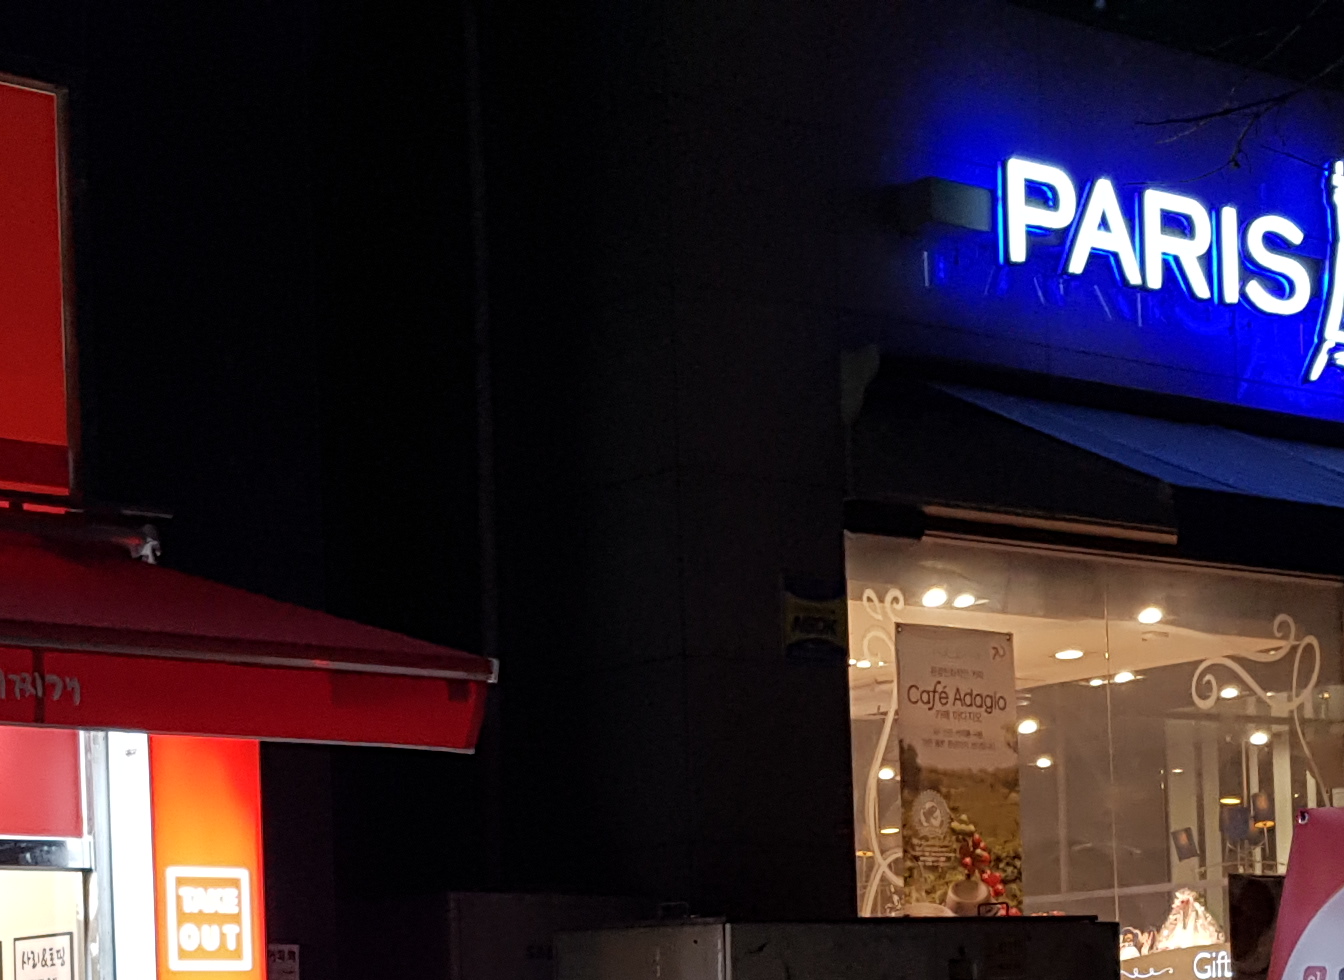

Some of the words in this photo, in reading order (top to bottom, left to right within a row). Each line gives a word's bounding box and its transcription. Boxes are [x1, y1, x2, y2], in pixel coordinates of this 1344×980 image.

[1002, 156, 1312, 316] PARIS
[907, 680, 949, 711] Café
[953, 688, 1007, 715] Adagio
[178, 886, 239, 914] TAKE
[178, 922, 240, 951] OUT
[1194, 951, 1233, 979] Gift
